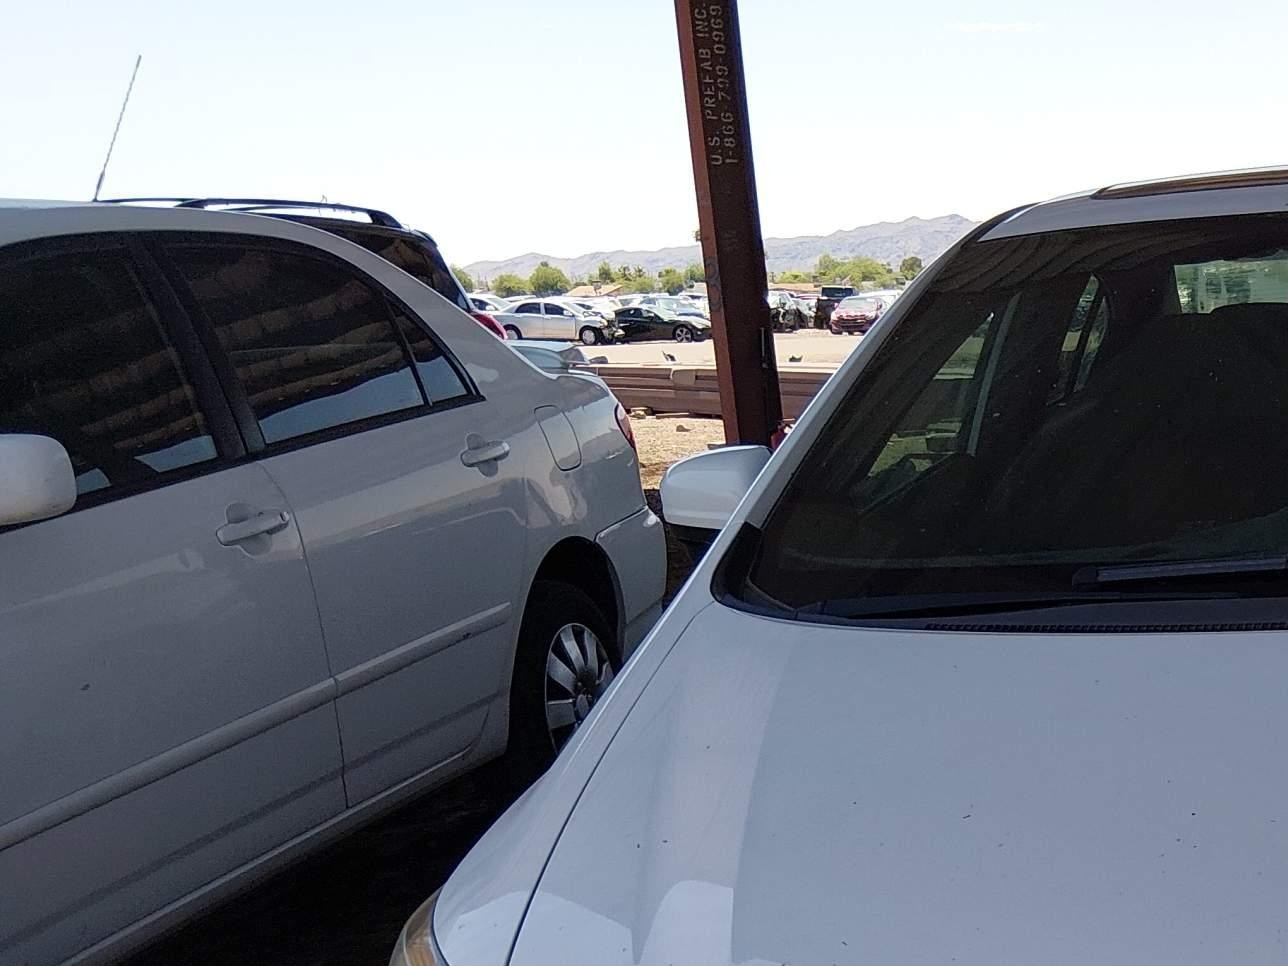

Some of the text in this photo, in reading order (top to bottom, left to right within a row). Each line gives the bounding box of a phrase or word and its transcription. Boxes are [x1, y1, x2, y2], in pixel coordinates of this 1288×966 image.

[694, 2, 722, 165] U.S. PREFAB INC.
[709, 5, 738, 164] 1-866-799-0969
